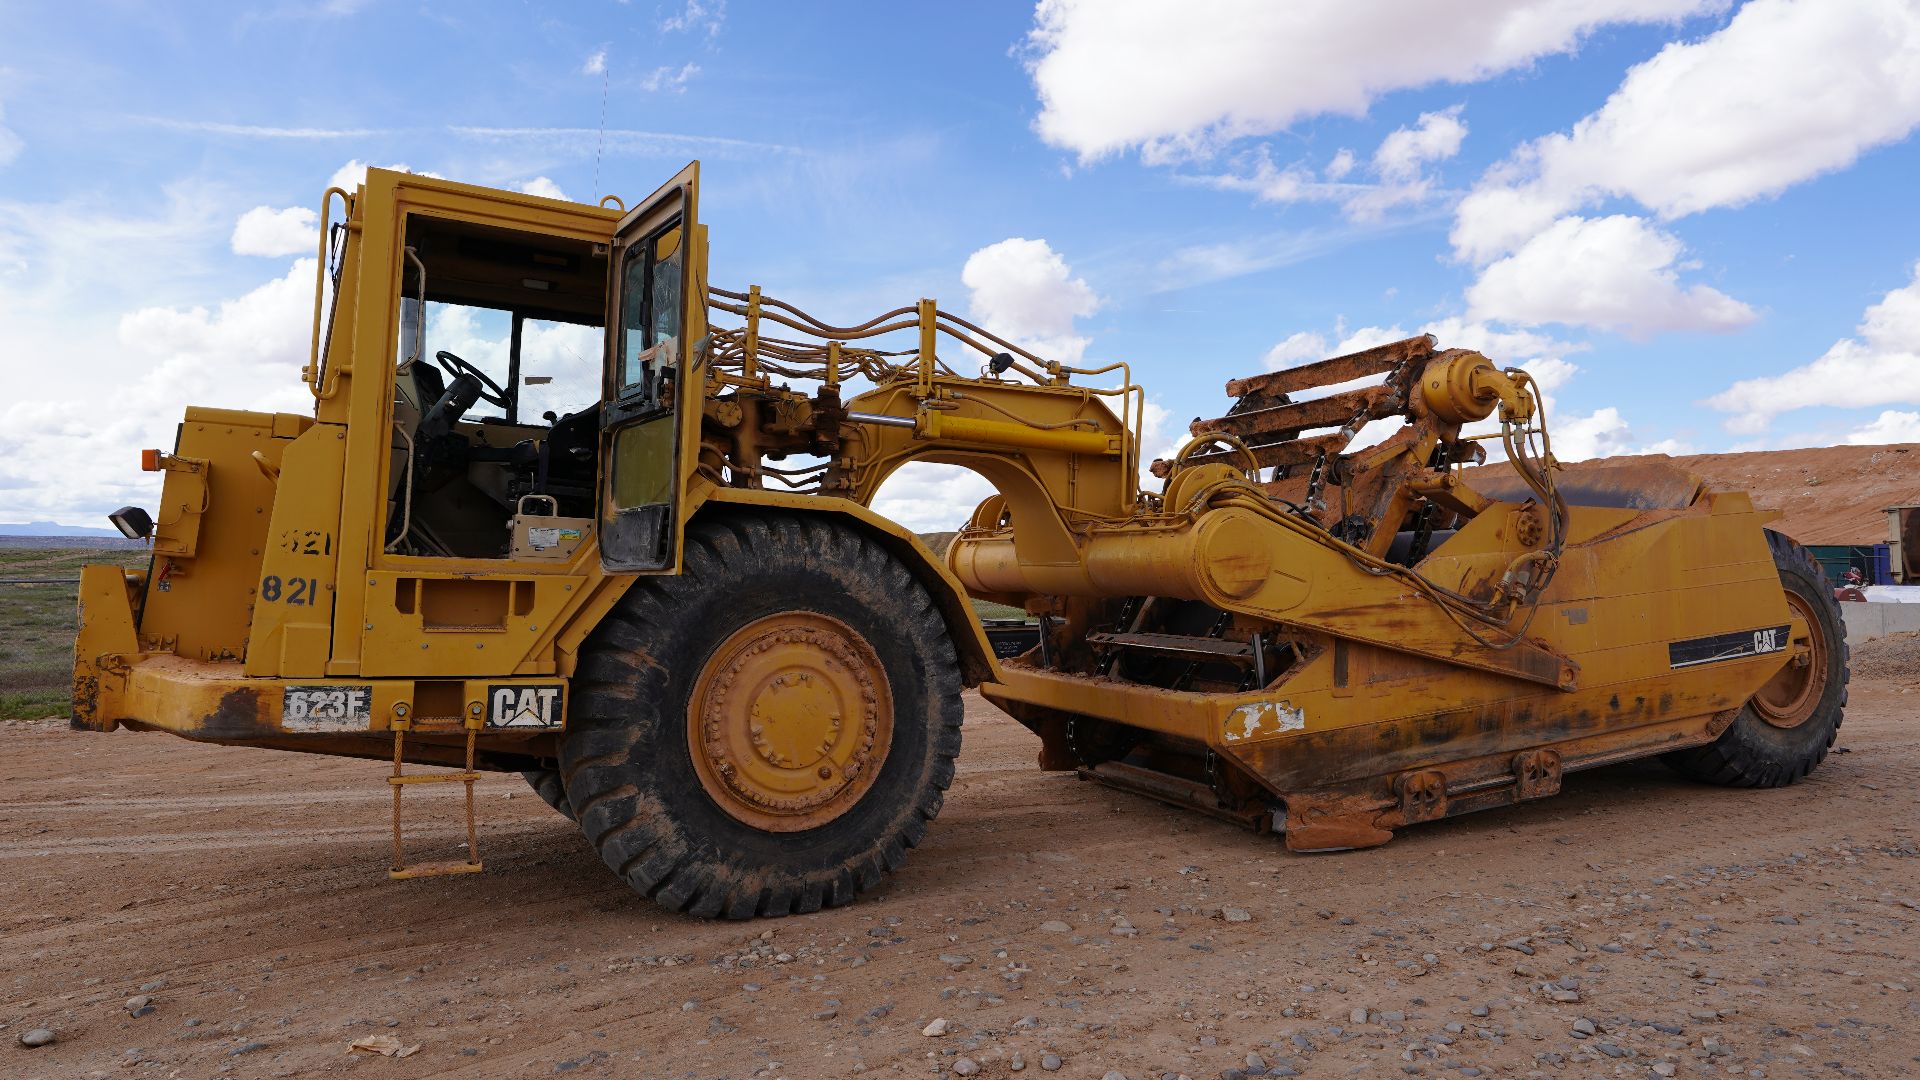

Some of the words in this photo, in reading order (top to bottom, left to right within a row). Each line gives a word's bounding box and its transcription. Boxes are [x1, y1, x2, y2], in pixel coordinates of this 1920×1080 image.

[262, 575, 317, 606] 821
[1754, 629, 1777, 653] CAT
[289, 691, 365, 718] 623F
[492, 688, 558, 727] CAT
